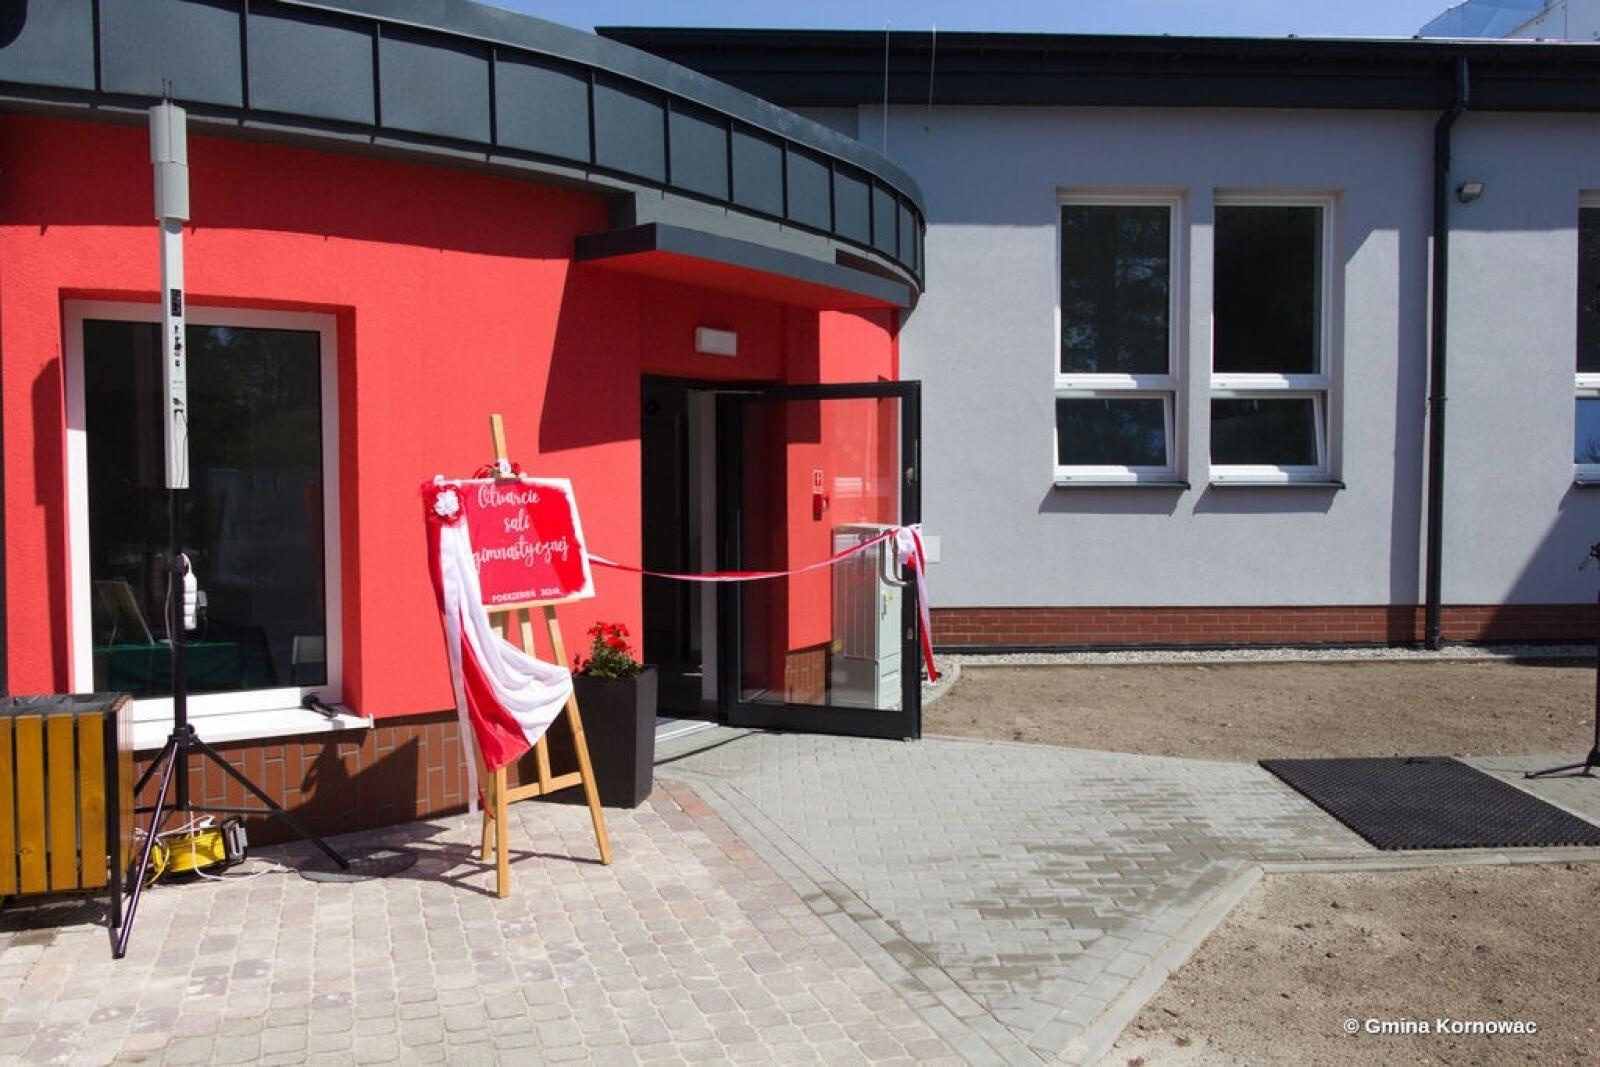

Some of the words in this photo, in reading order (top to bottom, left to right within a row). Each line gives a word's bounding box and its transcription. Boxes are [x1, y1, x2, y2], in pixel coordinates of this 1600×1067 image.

[478, 484, 540, 506] Otwarcie
[504, 508, 530, 532] sali
[472, 535, 570, 573] gimnastycznej
